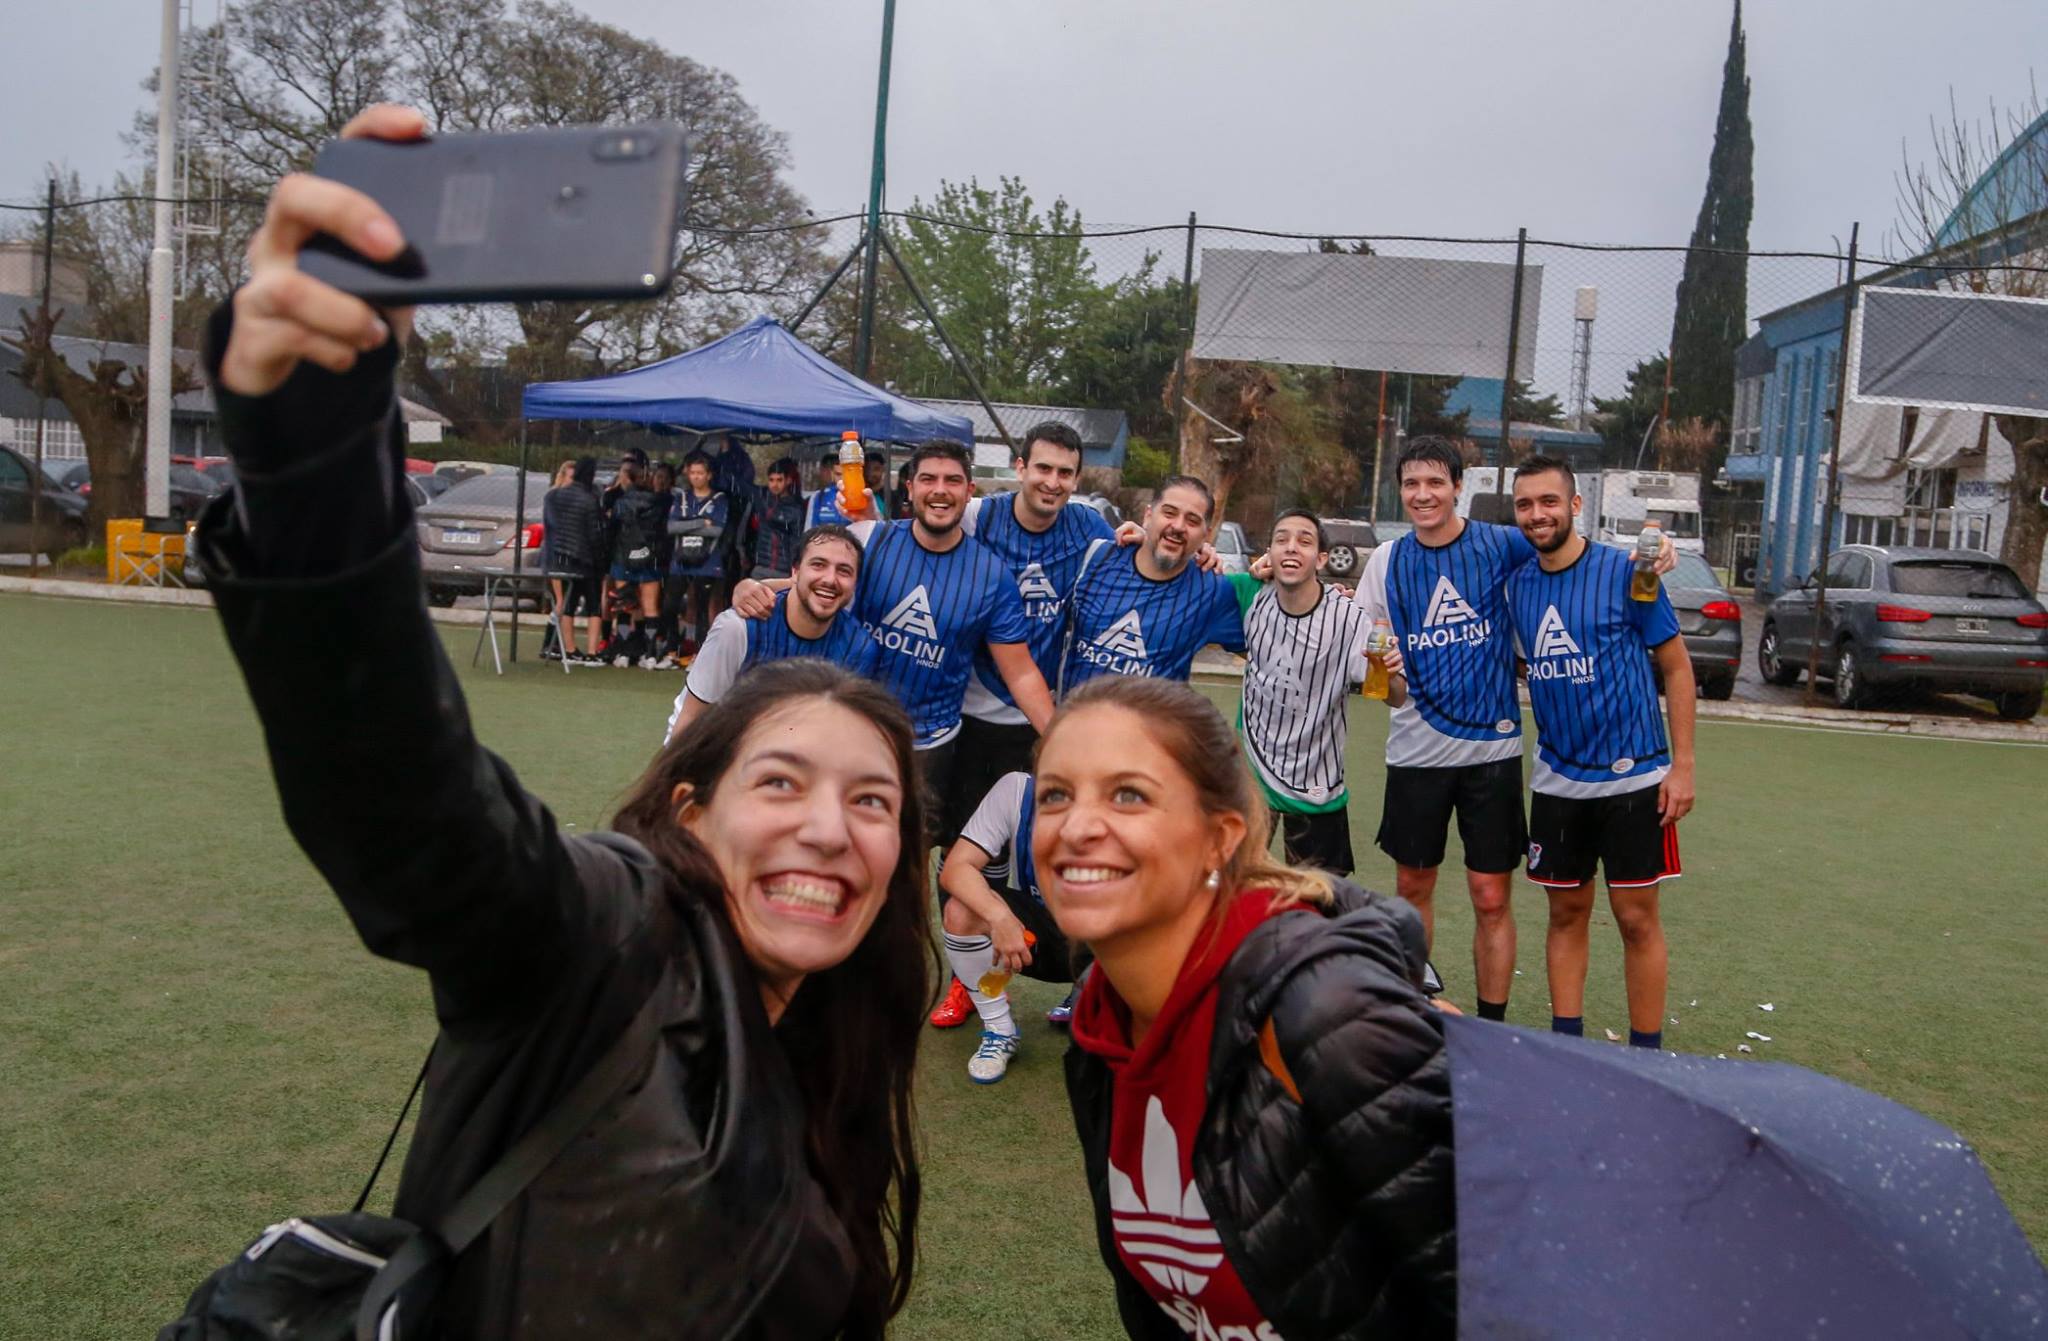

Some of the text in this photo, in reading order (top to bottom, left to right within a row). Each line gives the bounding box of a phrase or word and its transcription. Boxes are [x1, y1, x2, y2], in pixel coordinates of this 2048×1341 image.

[863, 621, 946, 663] PAOLINI
[1408, 619, 1490, 651] PAOLINI
[1077, 640, 1154, 678] PAOLINI
[1526, 656, 1594, 681] PAOLINI
[1572, 674, 1596, 685] HNOS
